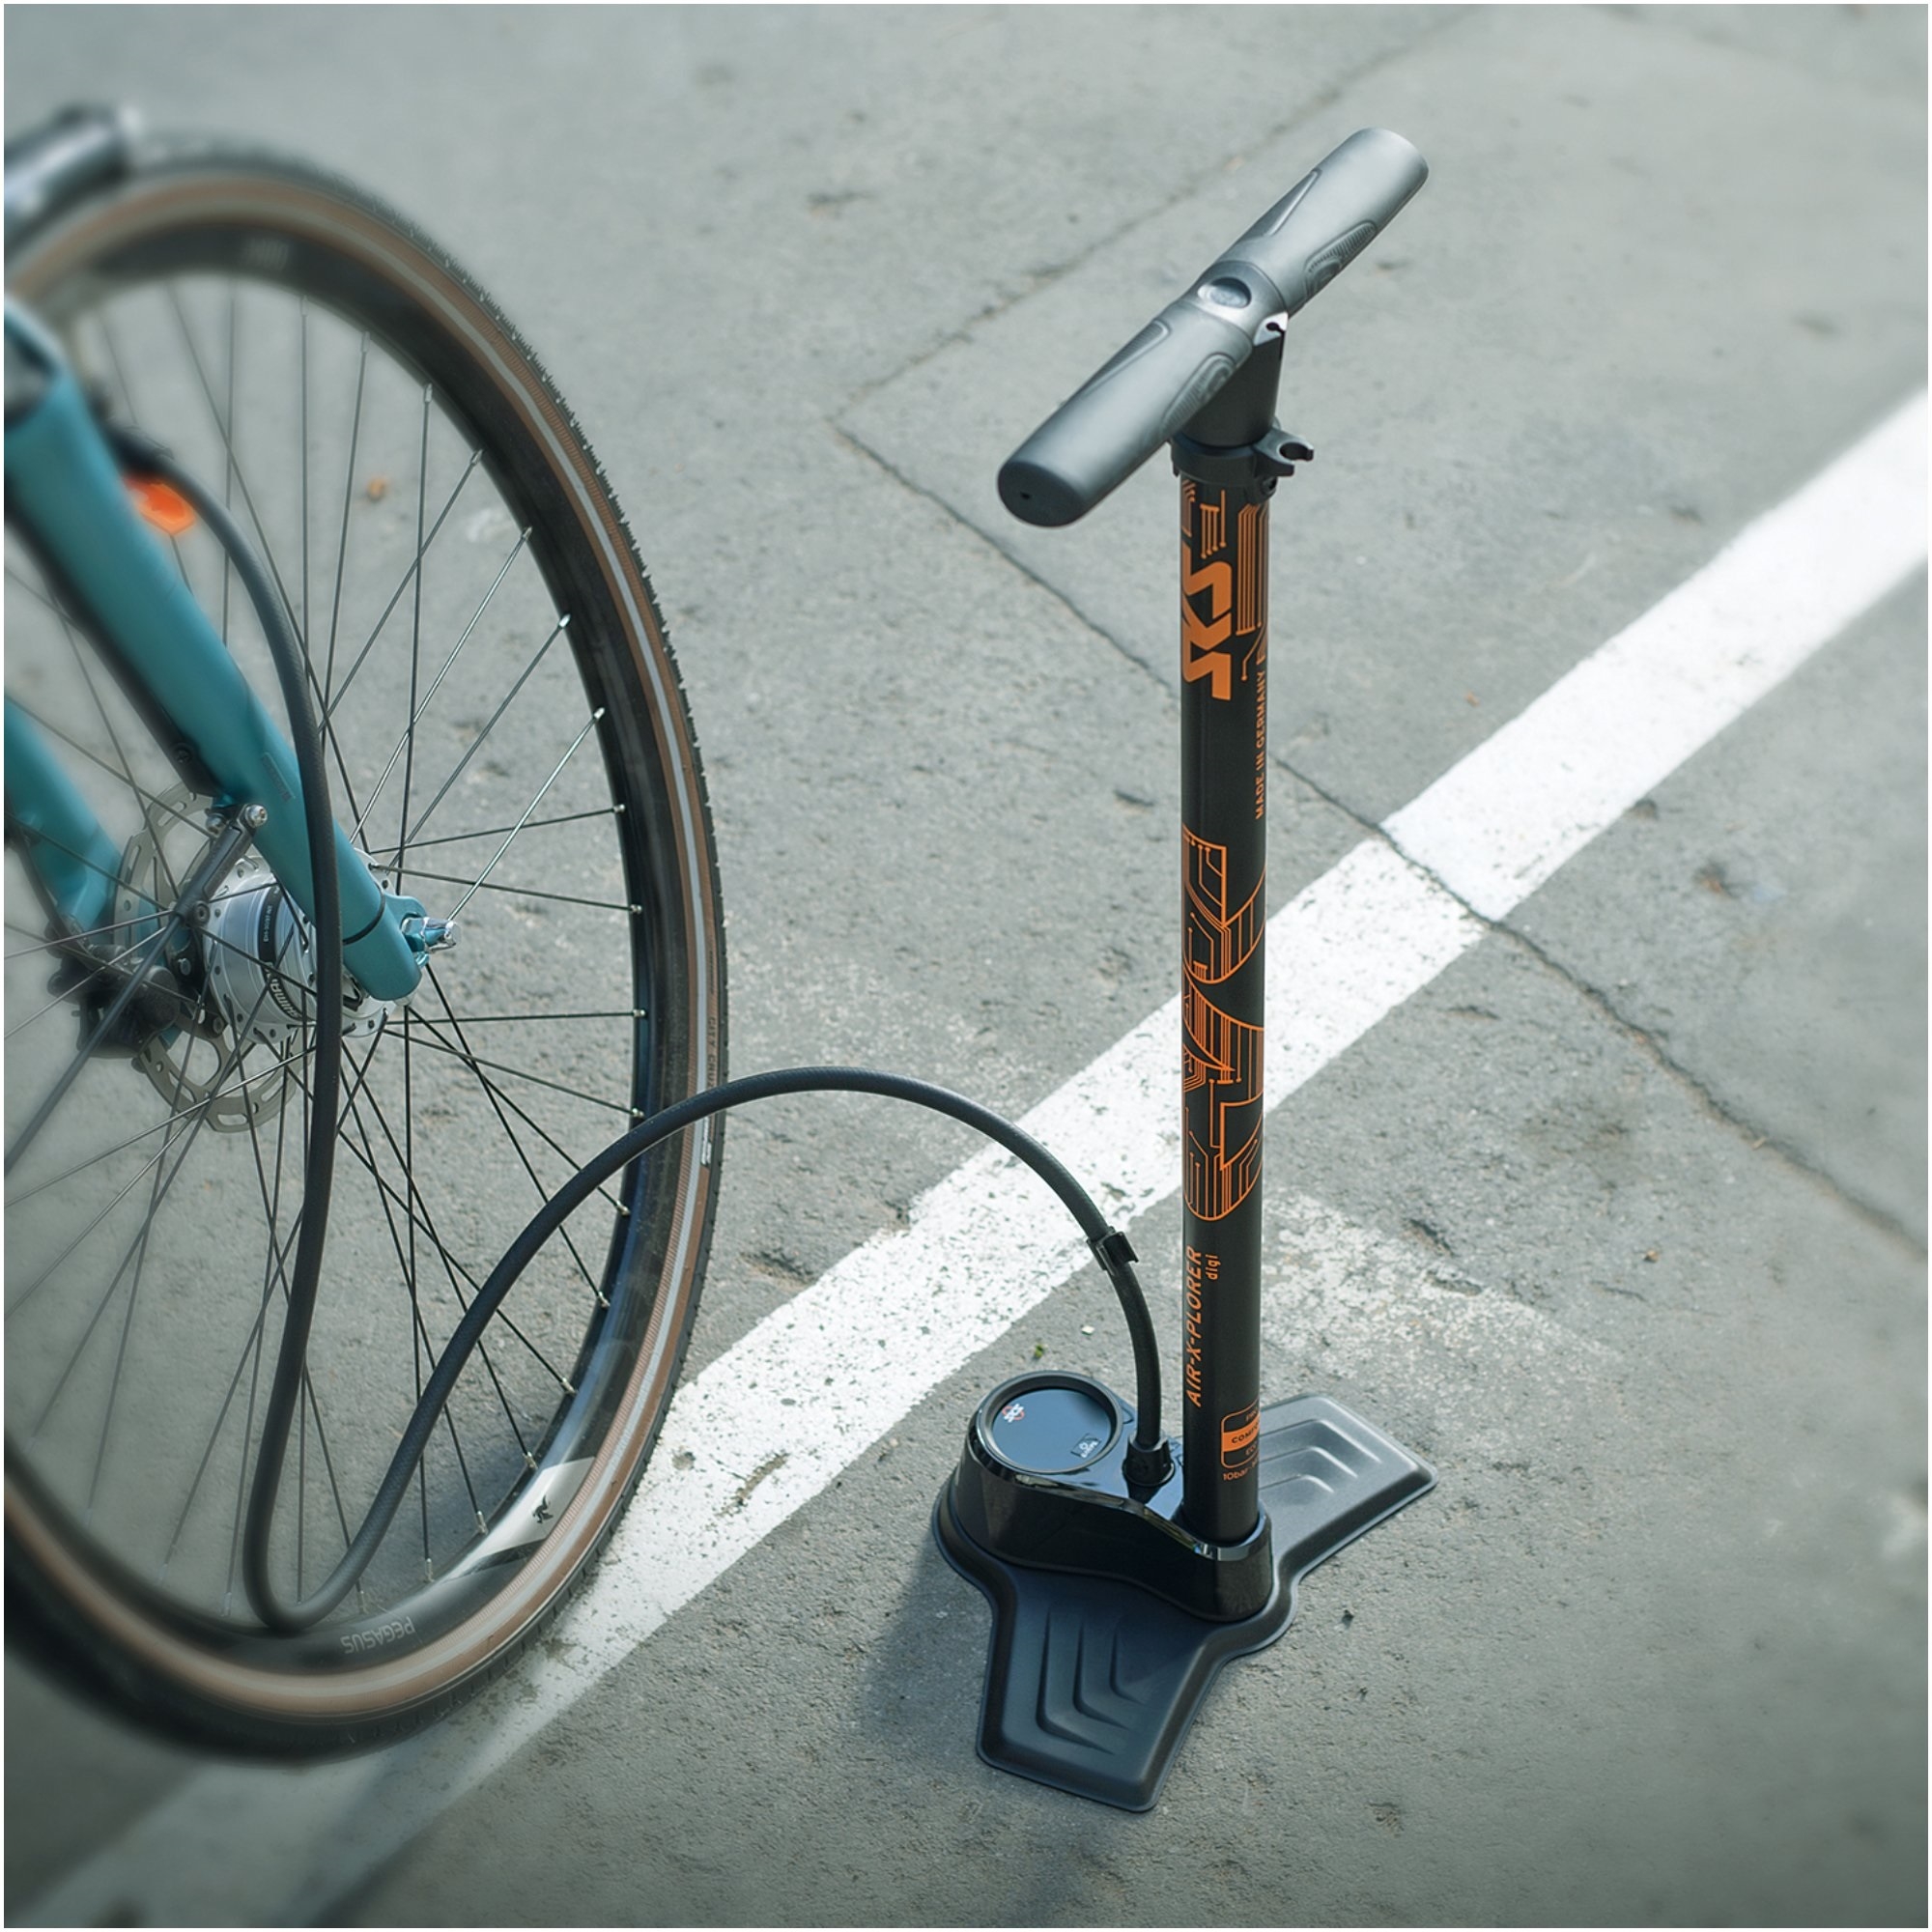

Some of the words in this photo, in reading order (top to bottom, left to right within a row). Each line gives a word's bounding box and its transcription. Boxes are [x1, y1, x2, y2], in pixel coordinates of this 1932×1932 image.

[1182, 541, 1232, 700] SKS
[1255, 670, 1267, 750] GERMANY
[1255, 753, 1266, 770] IN
[1254, 774, 1266, 819] MADE
[1205, 1254, 1221, 1281] digi
[1185, 1245, 1203, 1408] AIR-X-PLORER
[340, 1616, 416, 1654] PEGASUS
